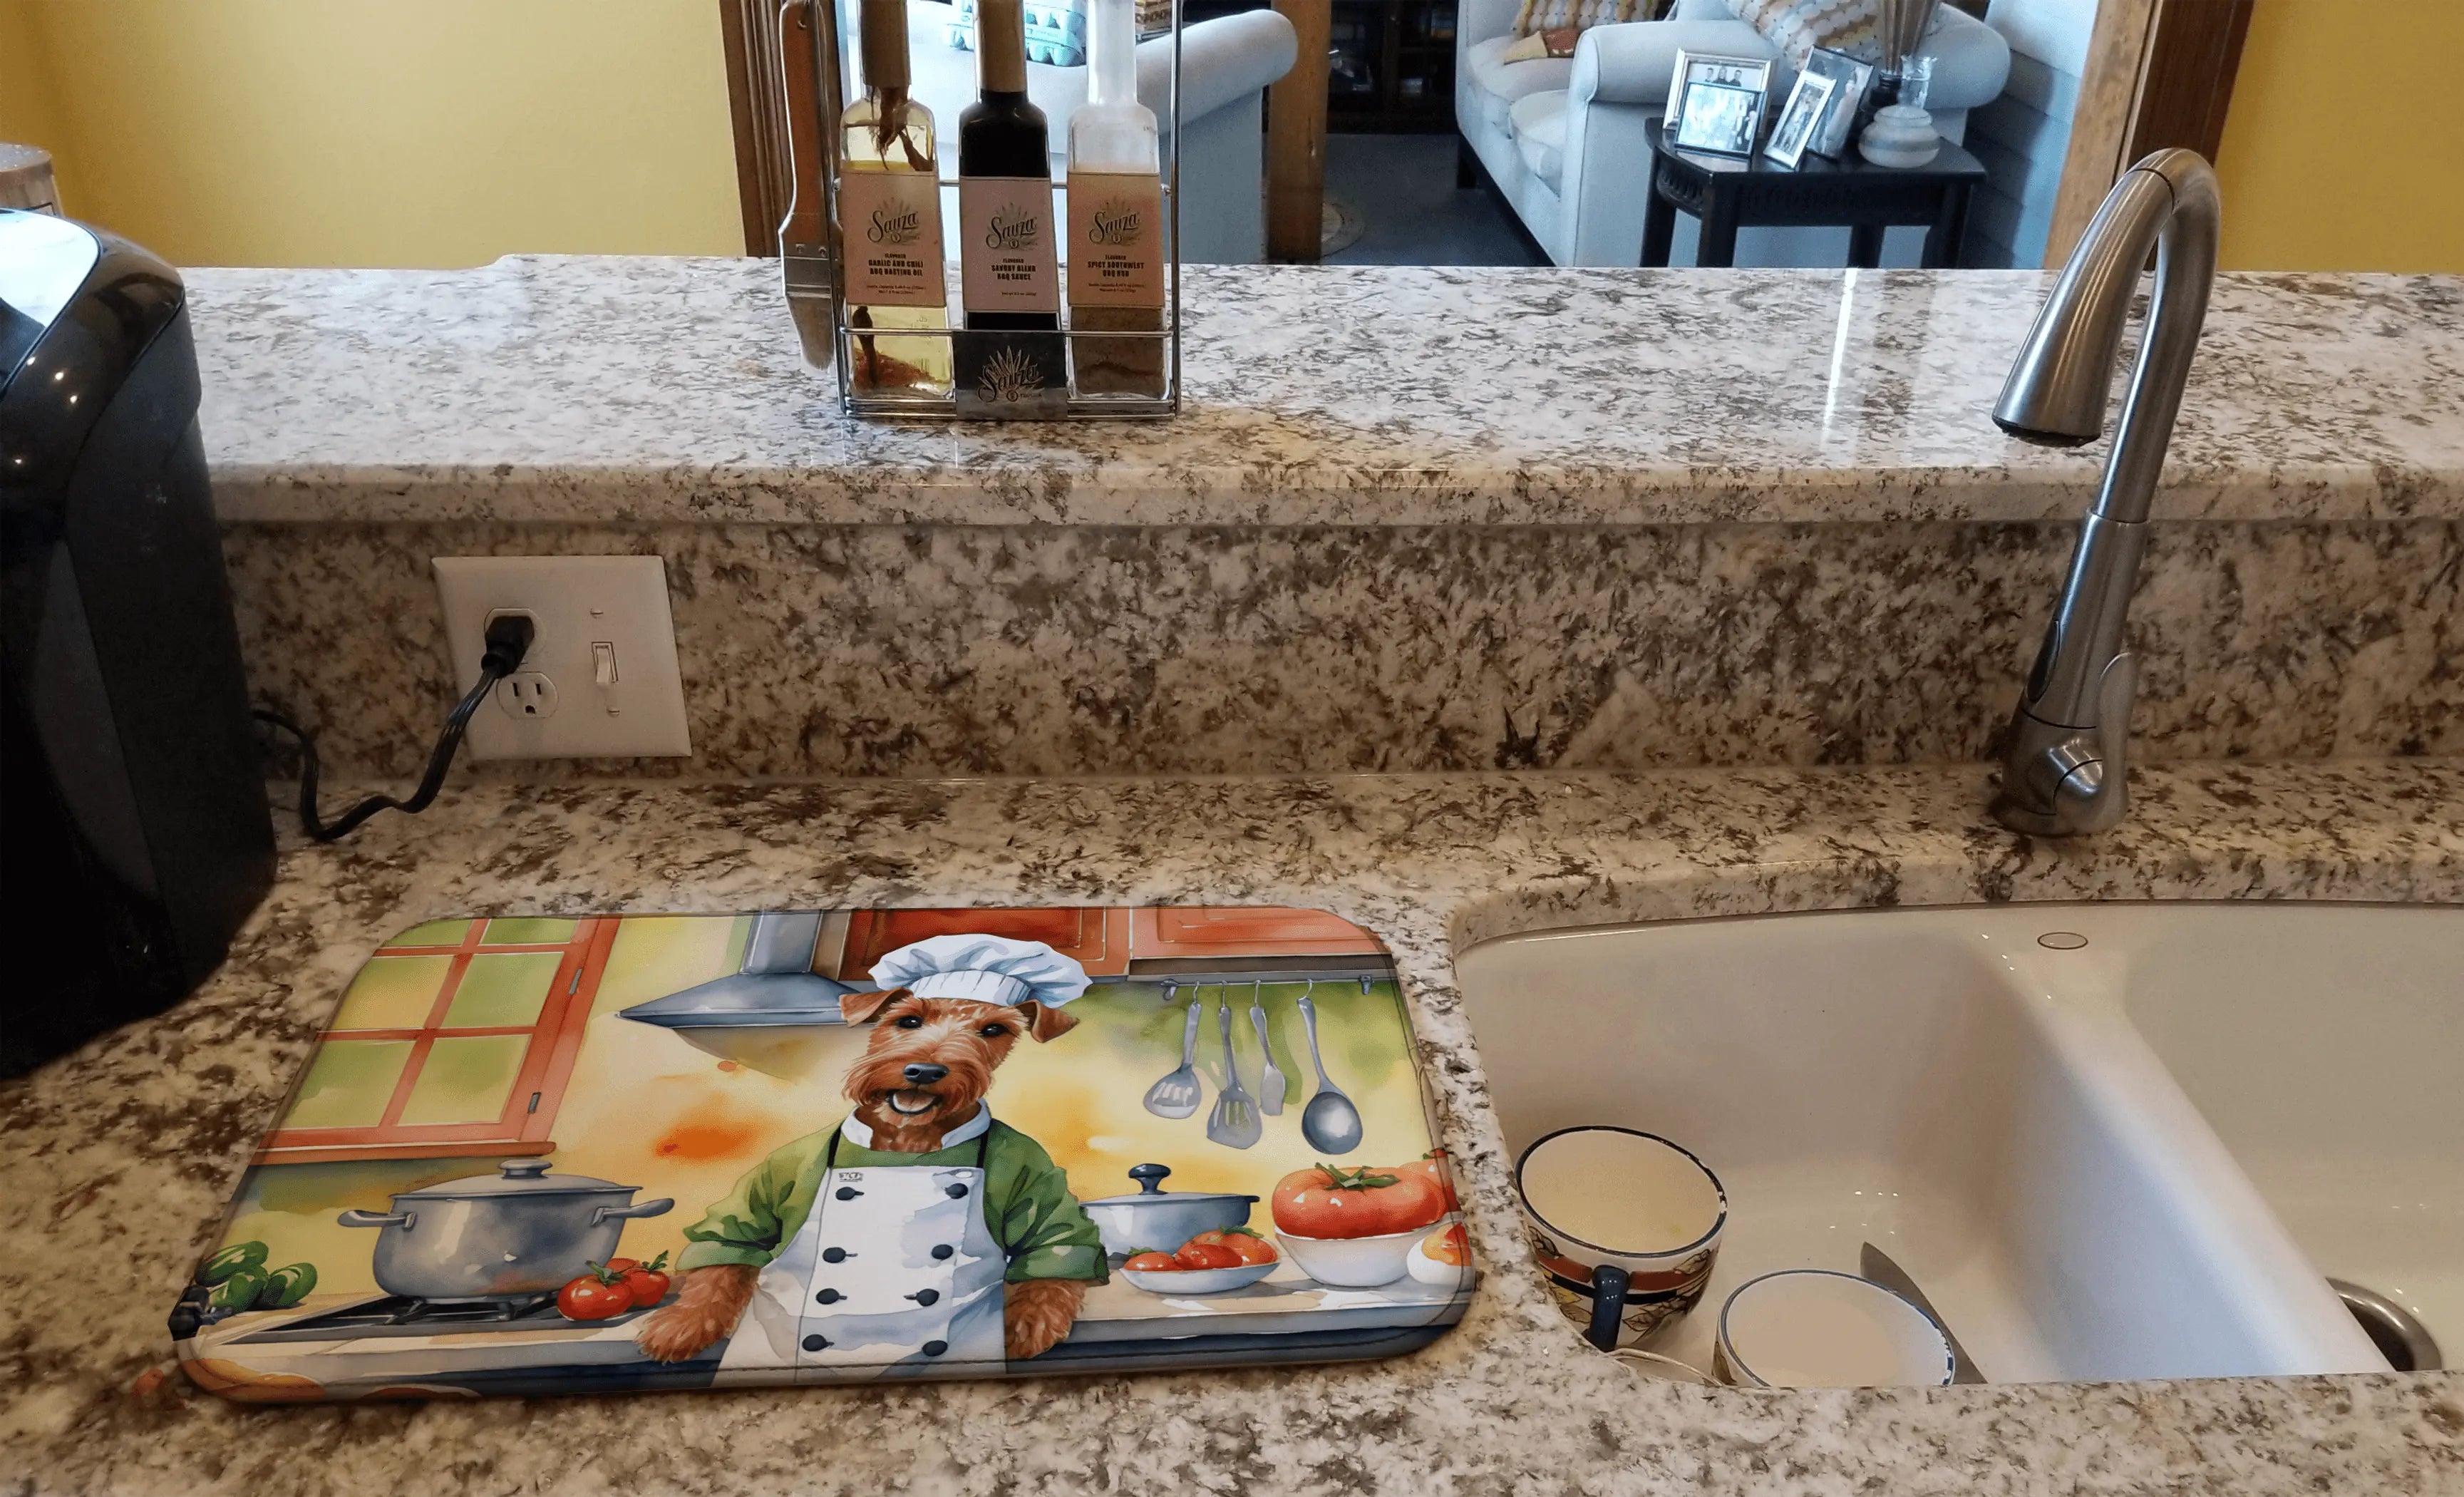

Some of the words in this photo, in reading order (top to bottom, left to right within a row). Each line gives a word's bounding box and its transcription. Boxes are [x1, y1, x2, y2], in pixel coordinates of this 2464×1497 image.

[867, 210, 918, 243] Sauza
[986, 216, 1037, 249] Sauza
[1089, 211, 1140, 245] Sauza
[1107, 261, 1145, 269] SOUTHWEST
